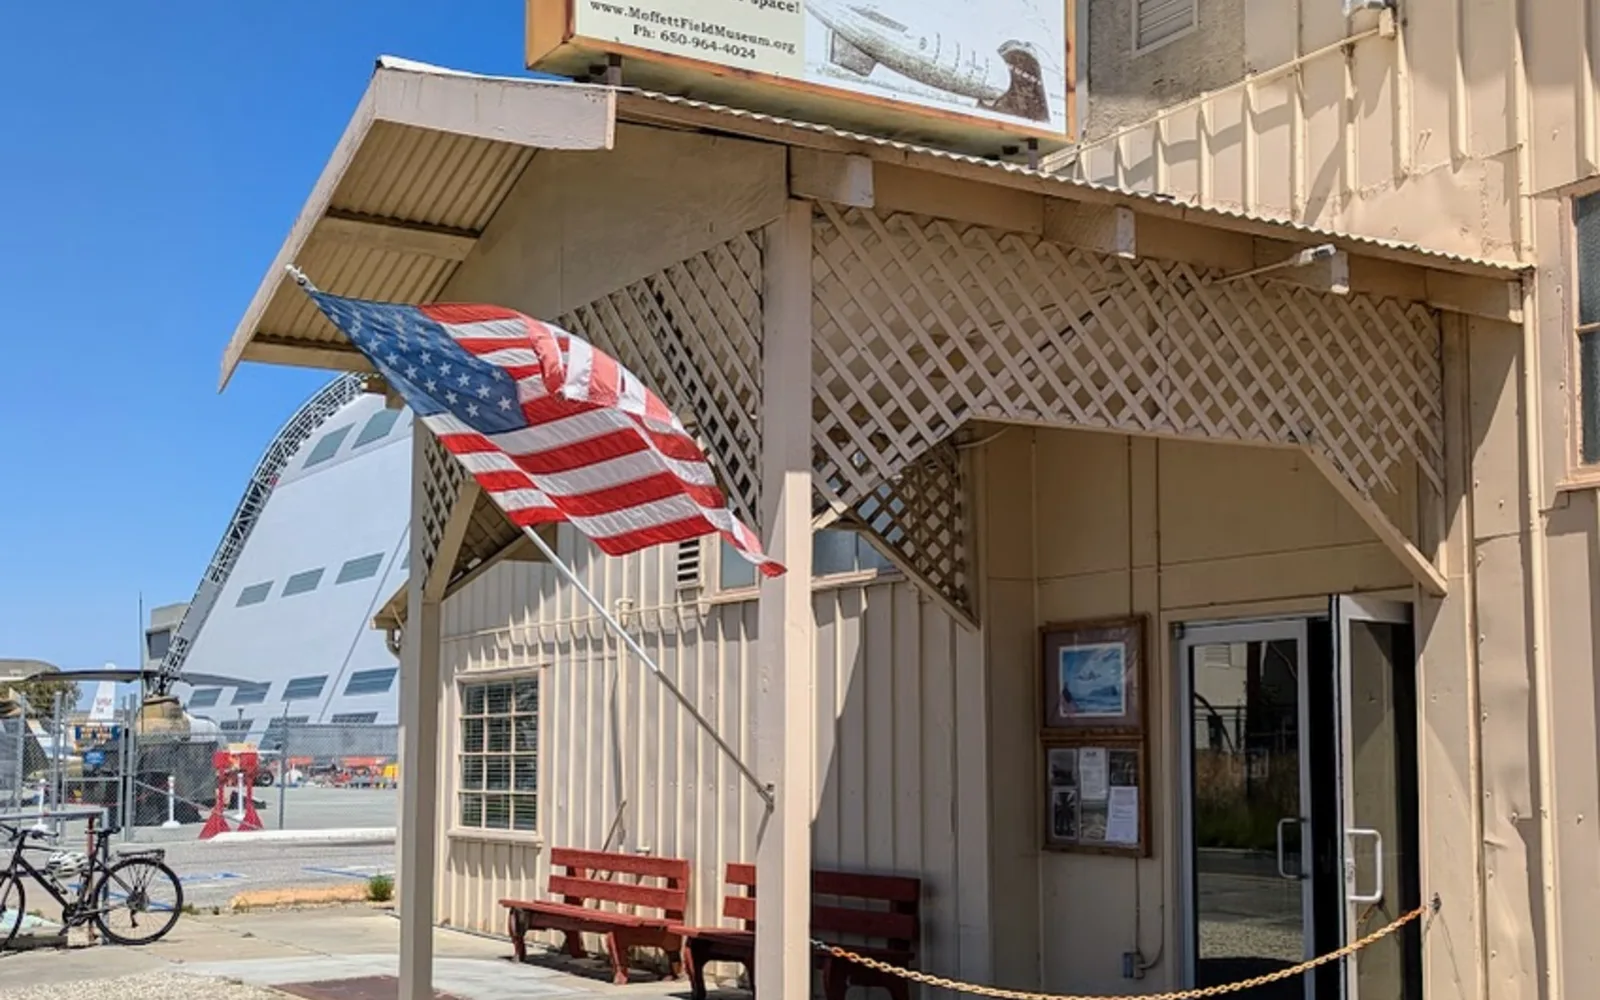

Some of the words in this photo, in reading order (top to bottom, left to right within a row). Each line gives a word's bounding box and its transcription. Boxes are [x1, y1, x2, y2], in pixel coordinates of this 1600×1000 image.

[590, 1, 796, 54] www.MoffettFieldMuseum.org
[633, 24, 656, 38] Ph:
[660, 30, 756, 59] 650-964-4024
